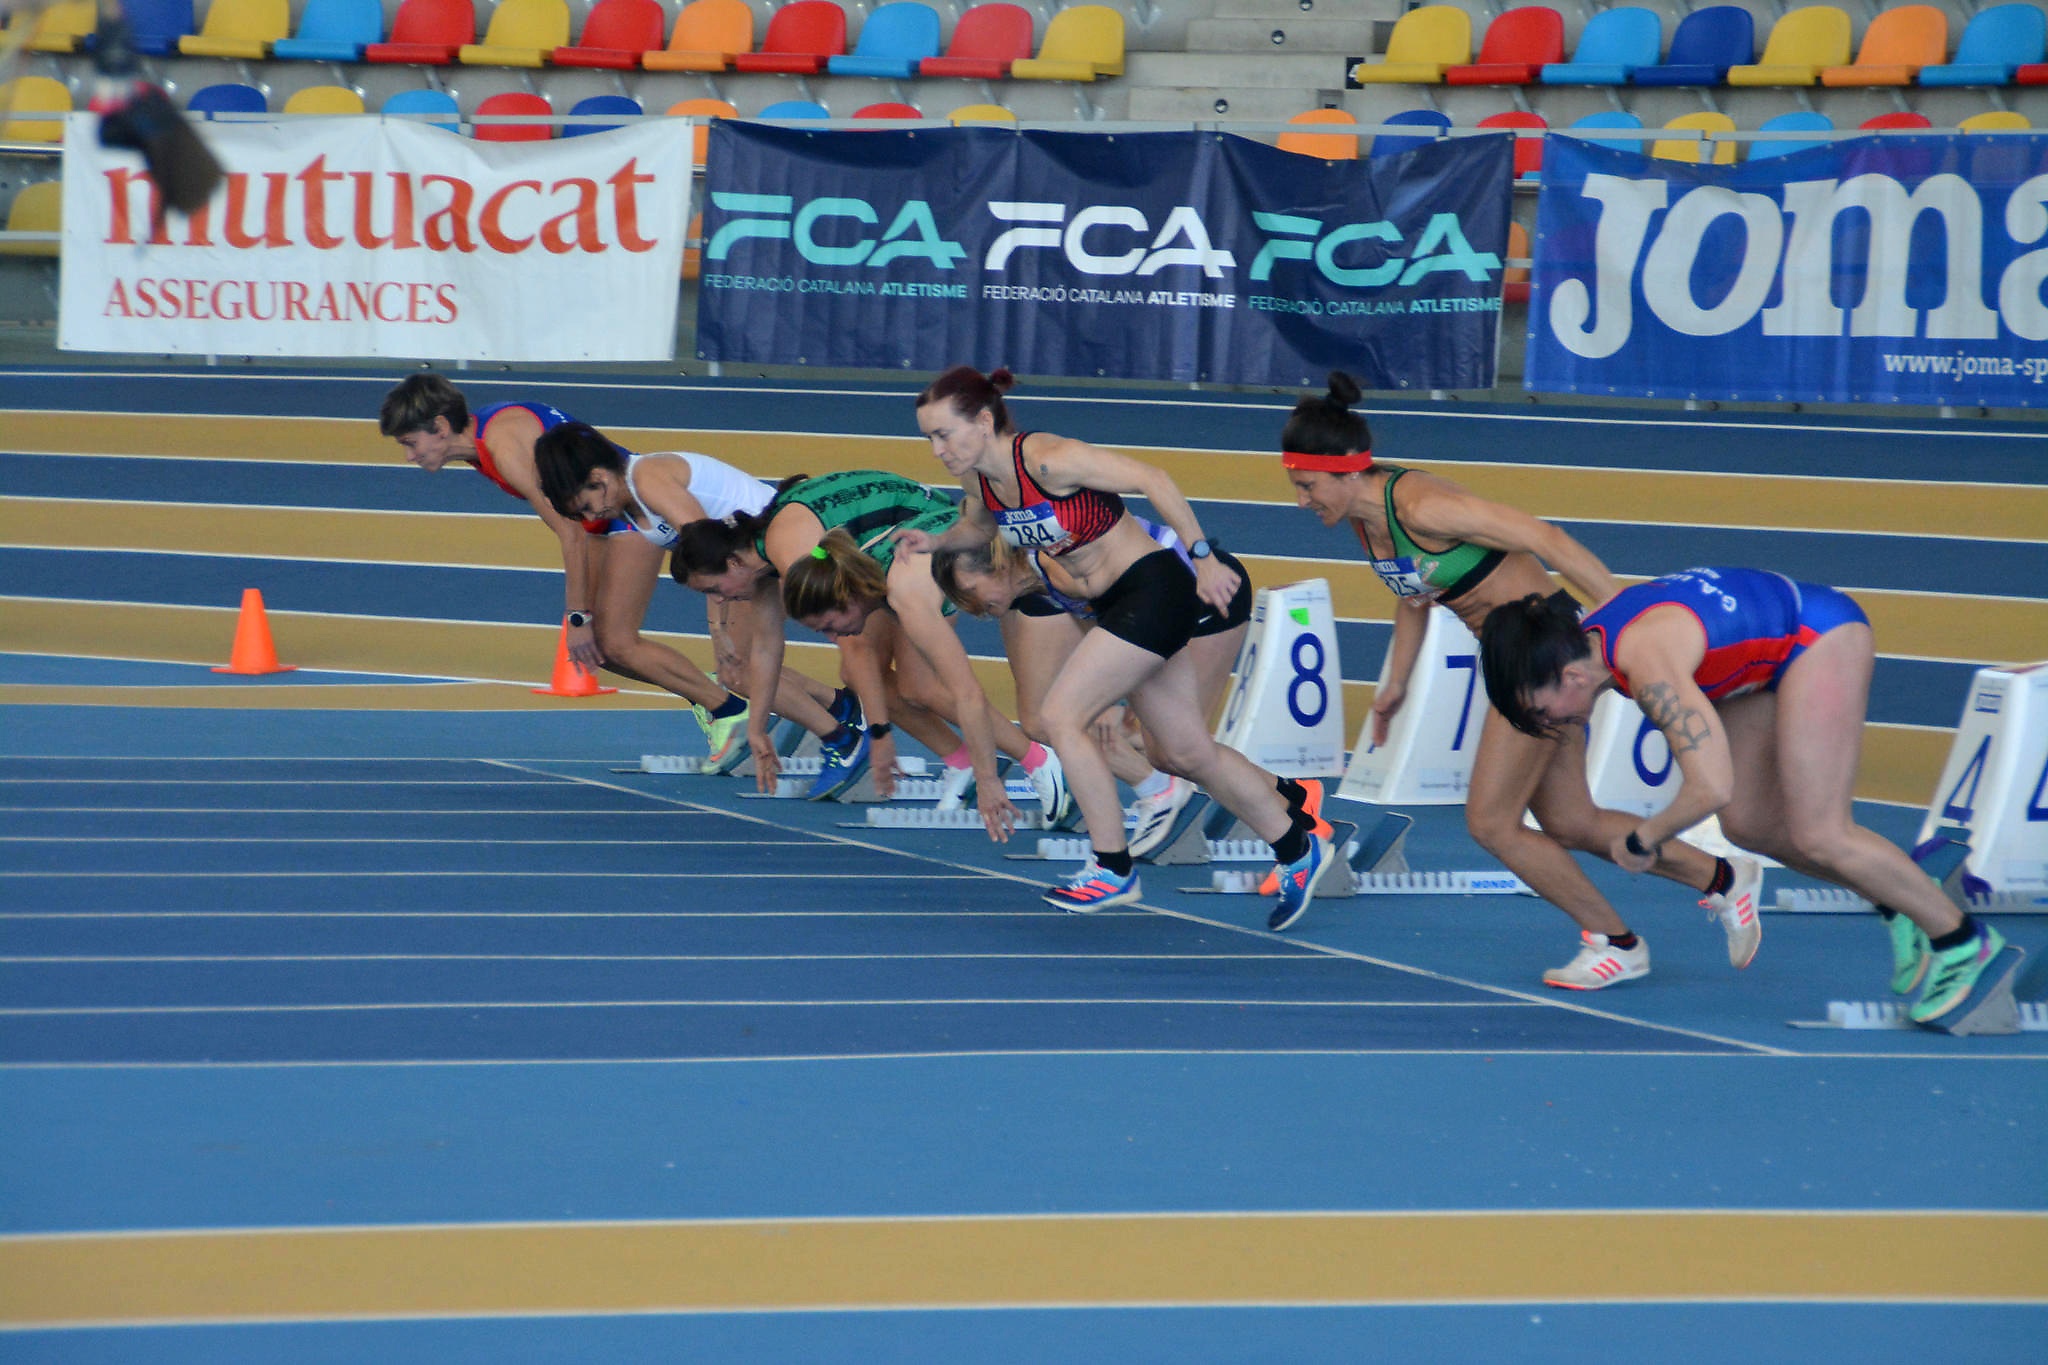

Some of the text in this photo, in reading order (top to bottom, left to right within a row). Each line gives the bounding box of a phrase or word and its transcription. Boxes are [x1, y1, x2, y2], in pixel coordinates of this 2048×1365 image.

[706, 191, 968, 269] FCA
[984, 200, 1237, 278] FCA
[1248, 210, 1503, 287] FCA
[103, 276, 458, 324] ASSEGURANCES
[704, 273, 968, 299] FEDERACIÓ CATALANA ATLETISME
[982, 283, 1236, 309] FEDERACIÓ CATALANA ATLETISME
[1326, 300, 1406, 316] CATALANA
[1408, 296, 1502, 314] ATLETISME
[1009, 522, 1057, 547] 284
[1287, 632, 1328, 728] 8
[1446, 655, 1477, 752] 7
[1942, 734, 1993, 827] 4
